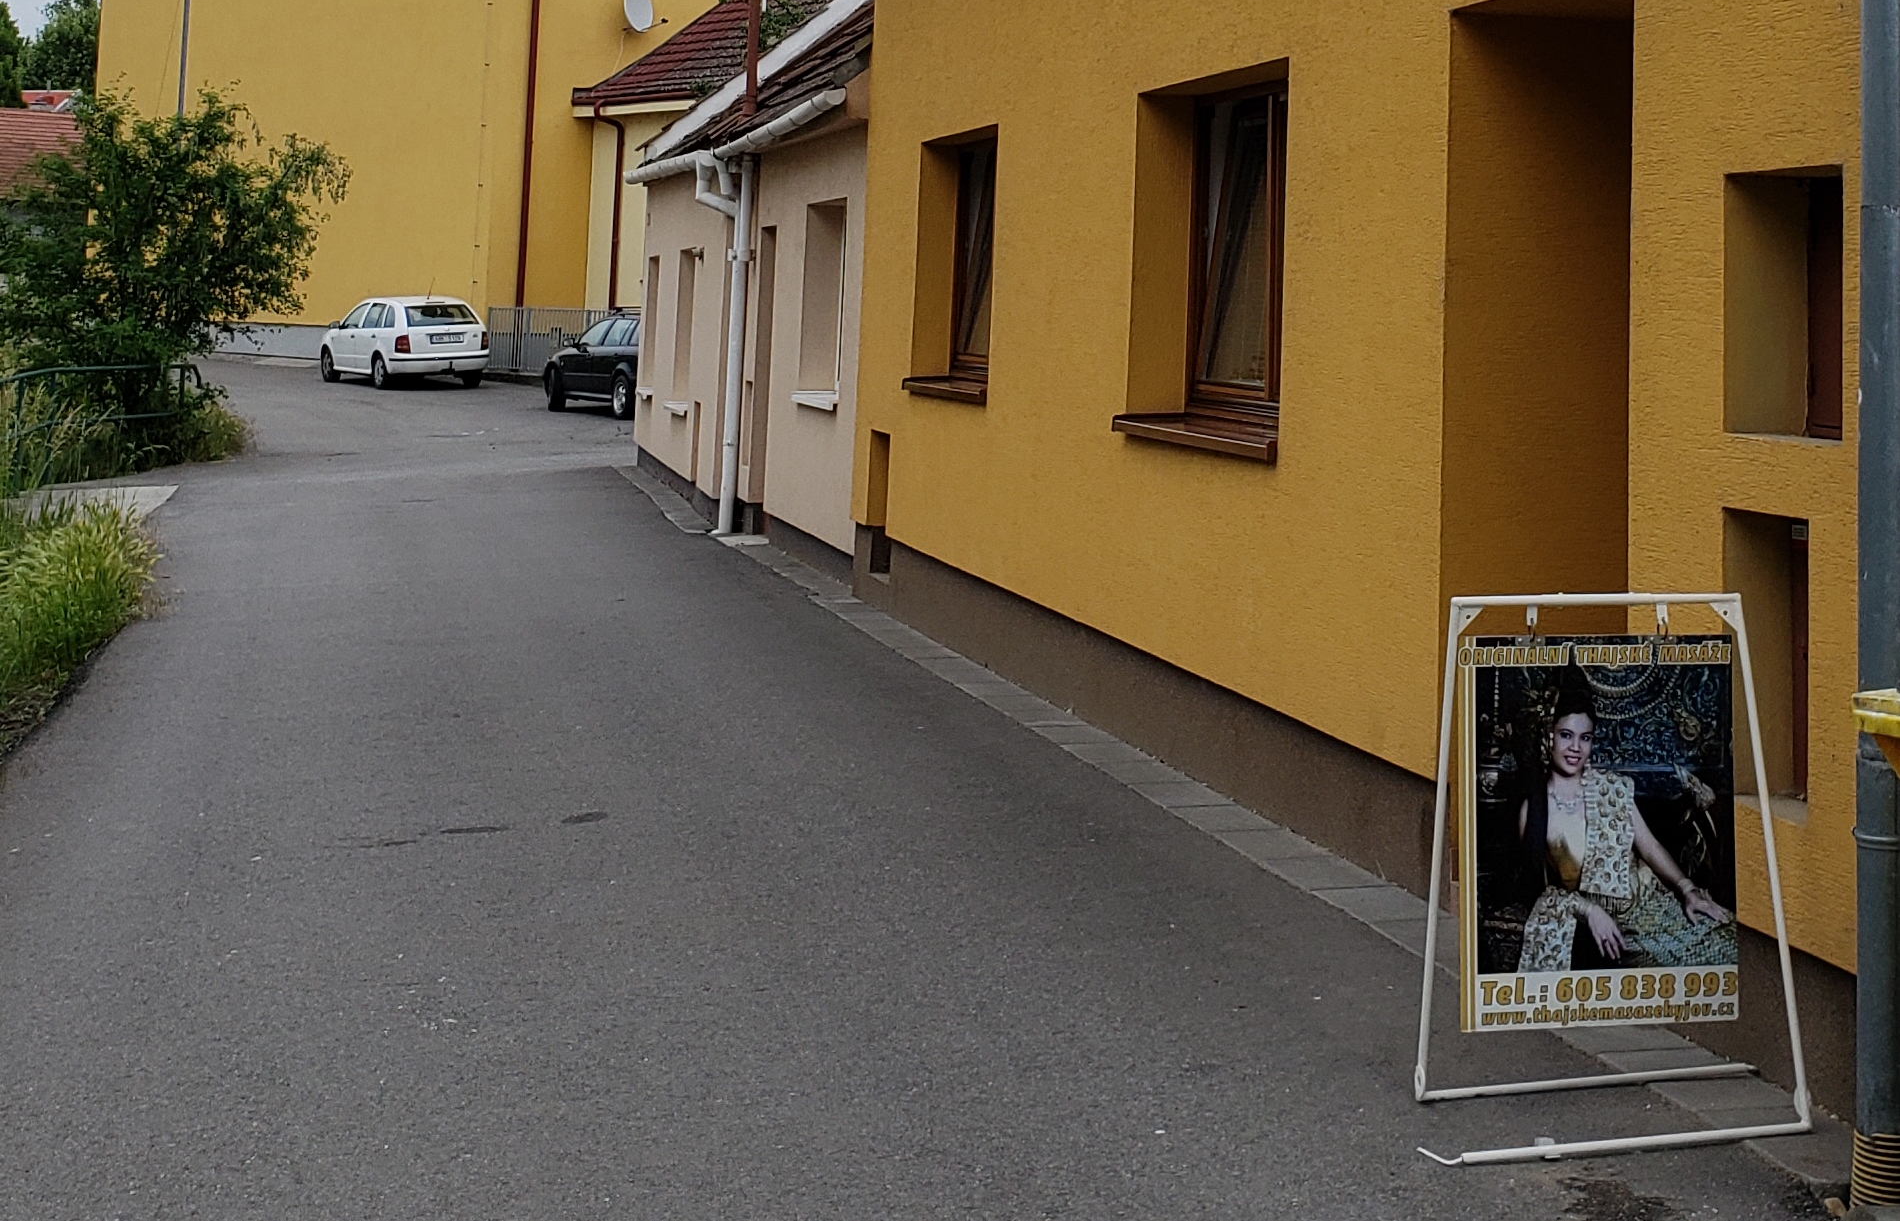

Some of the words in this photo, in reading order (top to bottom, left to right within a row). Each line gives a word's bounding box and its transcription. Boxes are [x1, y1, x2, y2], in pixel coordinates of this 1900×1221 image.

[1459, 643, 1570, 666] ORIGINÁLNÍ
[1576, 642, 1651, 667] THAJSKÉ
[1658, 641, 1731, 664] MASÁŽE
[1480, 977, 1549, 1006] Tel.:
[1555, 976, 1612, 1003] 605
[1619, 974, 1676, 999] 838
[1683, 971, 1738, 998] 993
[1481, 1000, 1735, 1026] www.thajskemasazekyjov.cz
